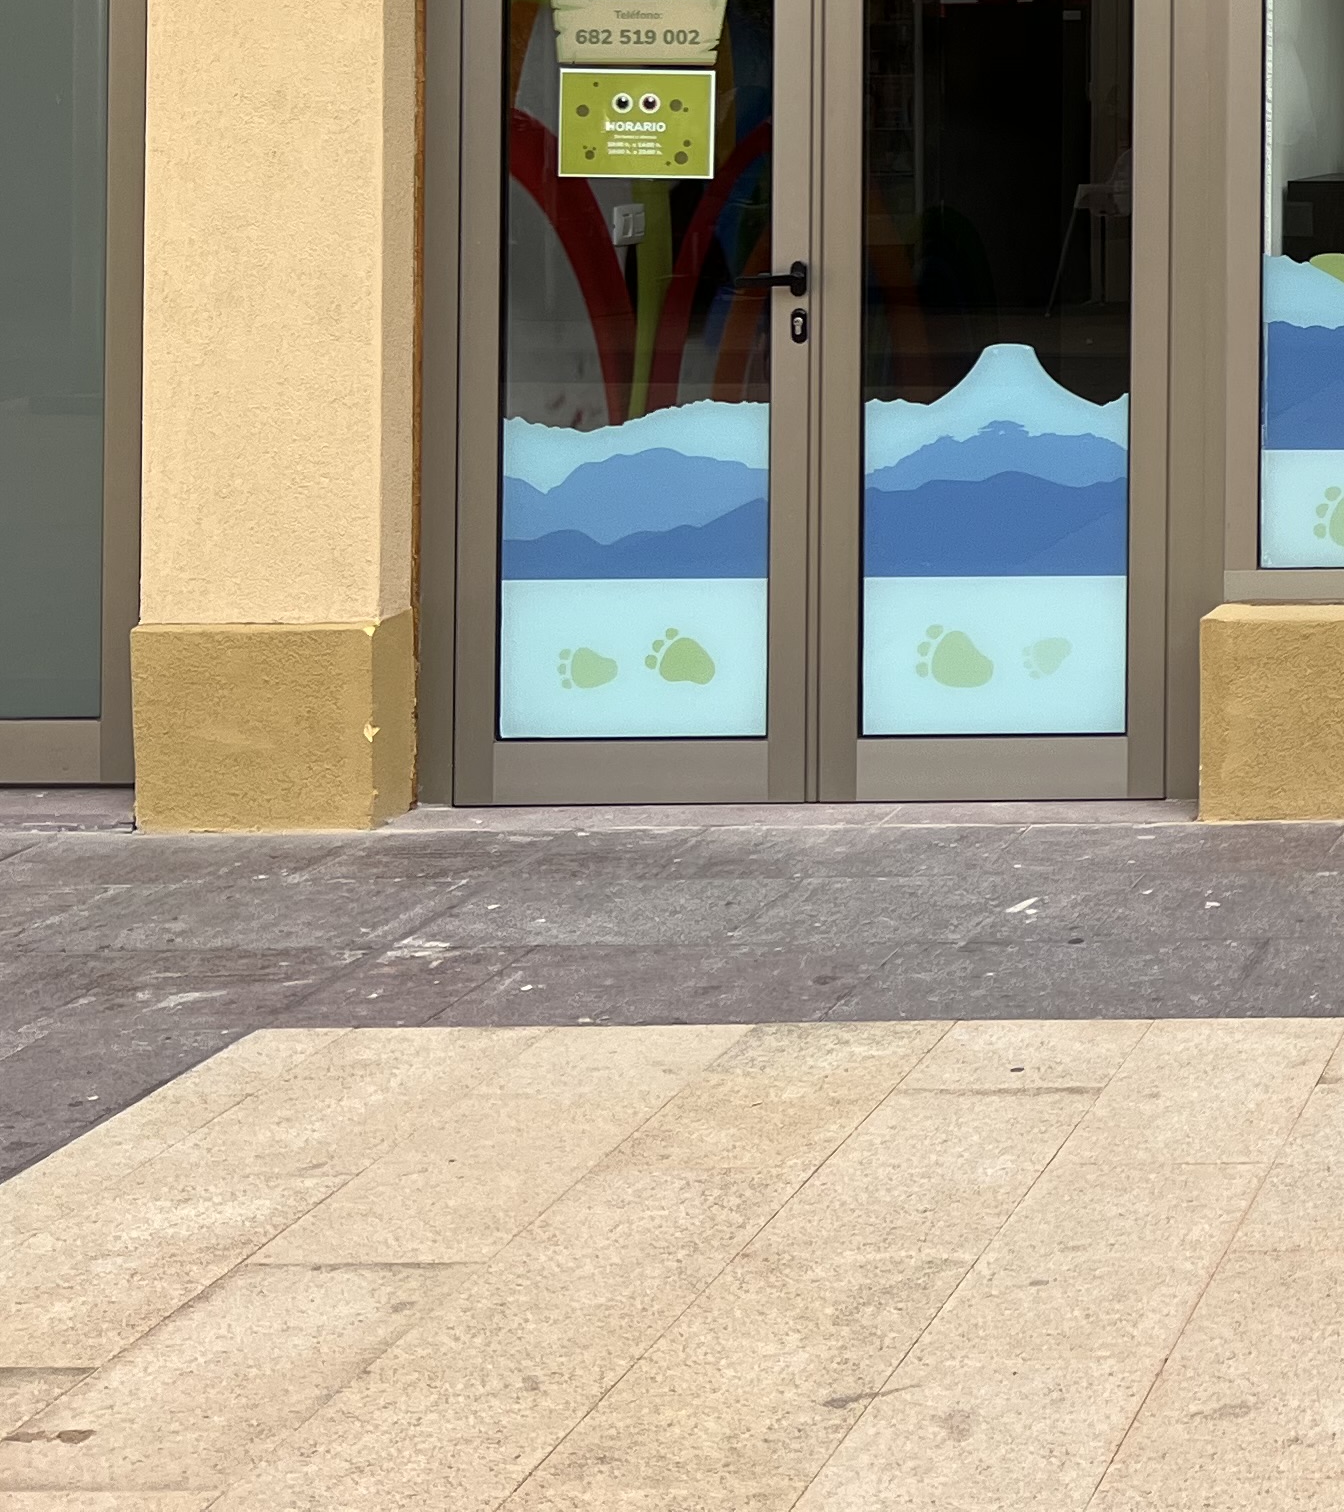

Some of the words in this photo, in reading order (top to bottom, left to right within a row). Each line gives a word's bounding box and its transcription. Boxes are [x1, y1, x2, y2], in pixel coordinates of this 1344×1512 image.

[614, 9, 663, 21] Teléfono:
[575, 29, 612, 45] 682
[619, 29, 657, 45] 519
[663, 29, 701, 45] 002
[605, 121, 667, 133] HORARIO
